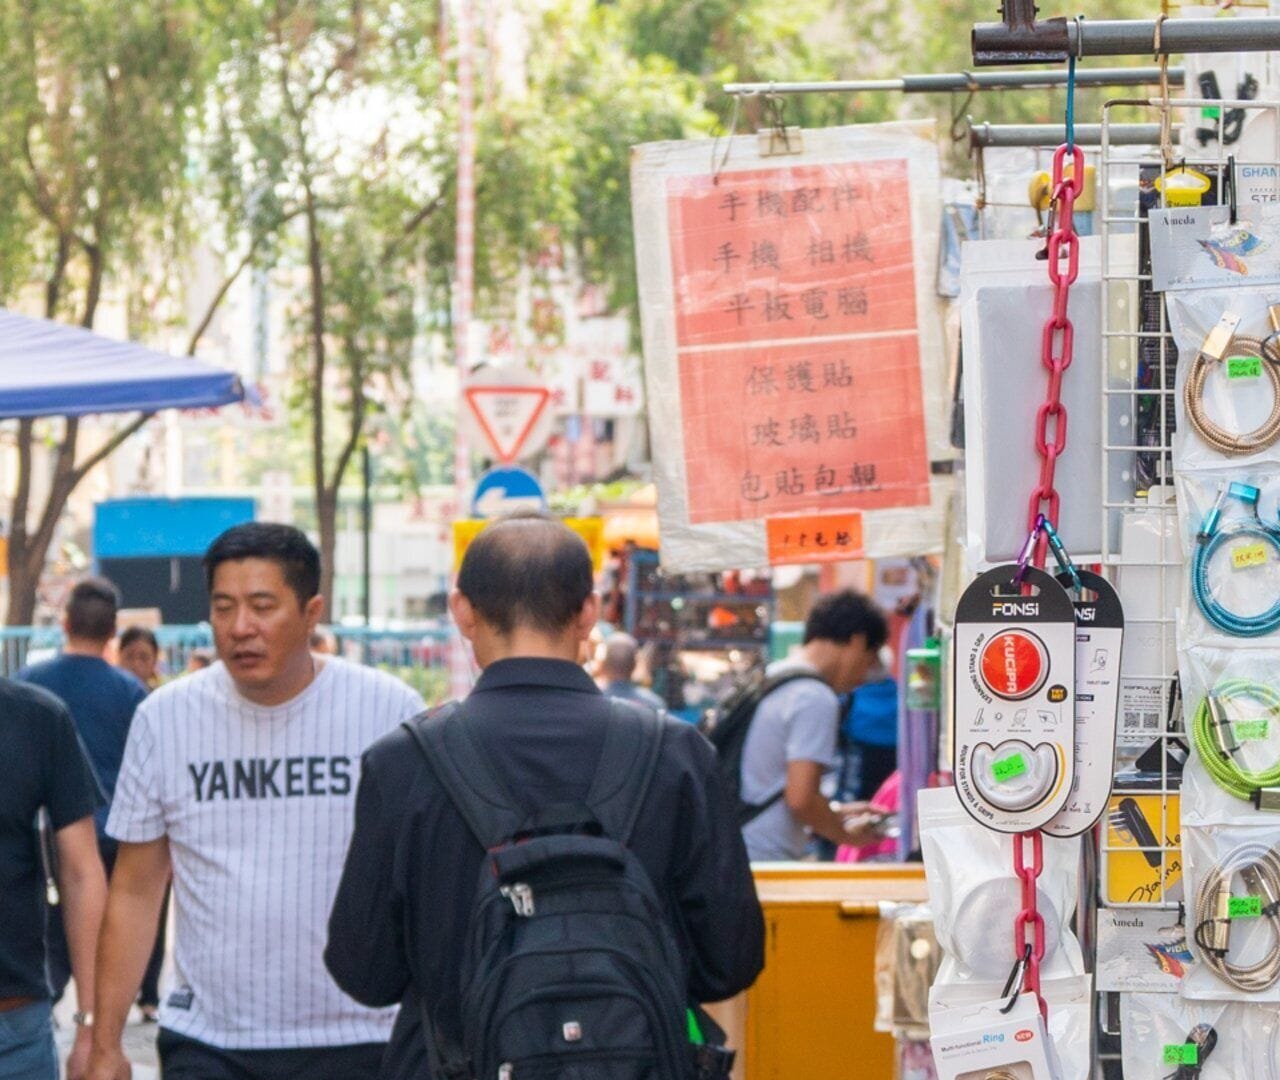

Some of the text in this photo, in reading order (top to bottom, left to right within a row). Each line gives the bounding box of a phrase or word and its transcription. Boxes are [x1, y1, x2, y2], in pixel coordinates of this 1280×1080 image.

[188, 756, 352, 801] YANKEES
[1111, 918, 1144, 928] Ameda
[983, 1033, 1006, 1044] Ring
